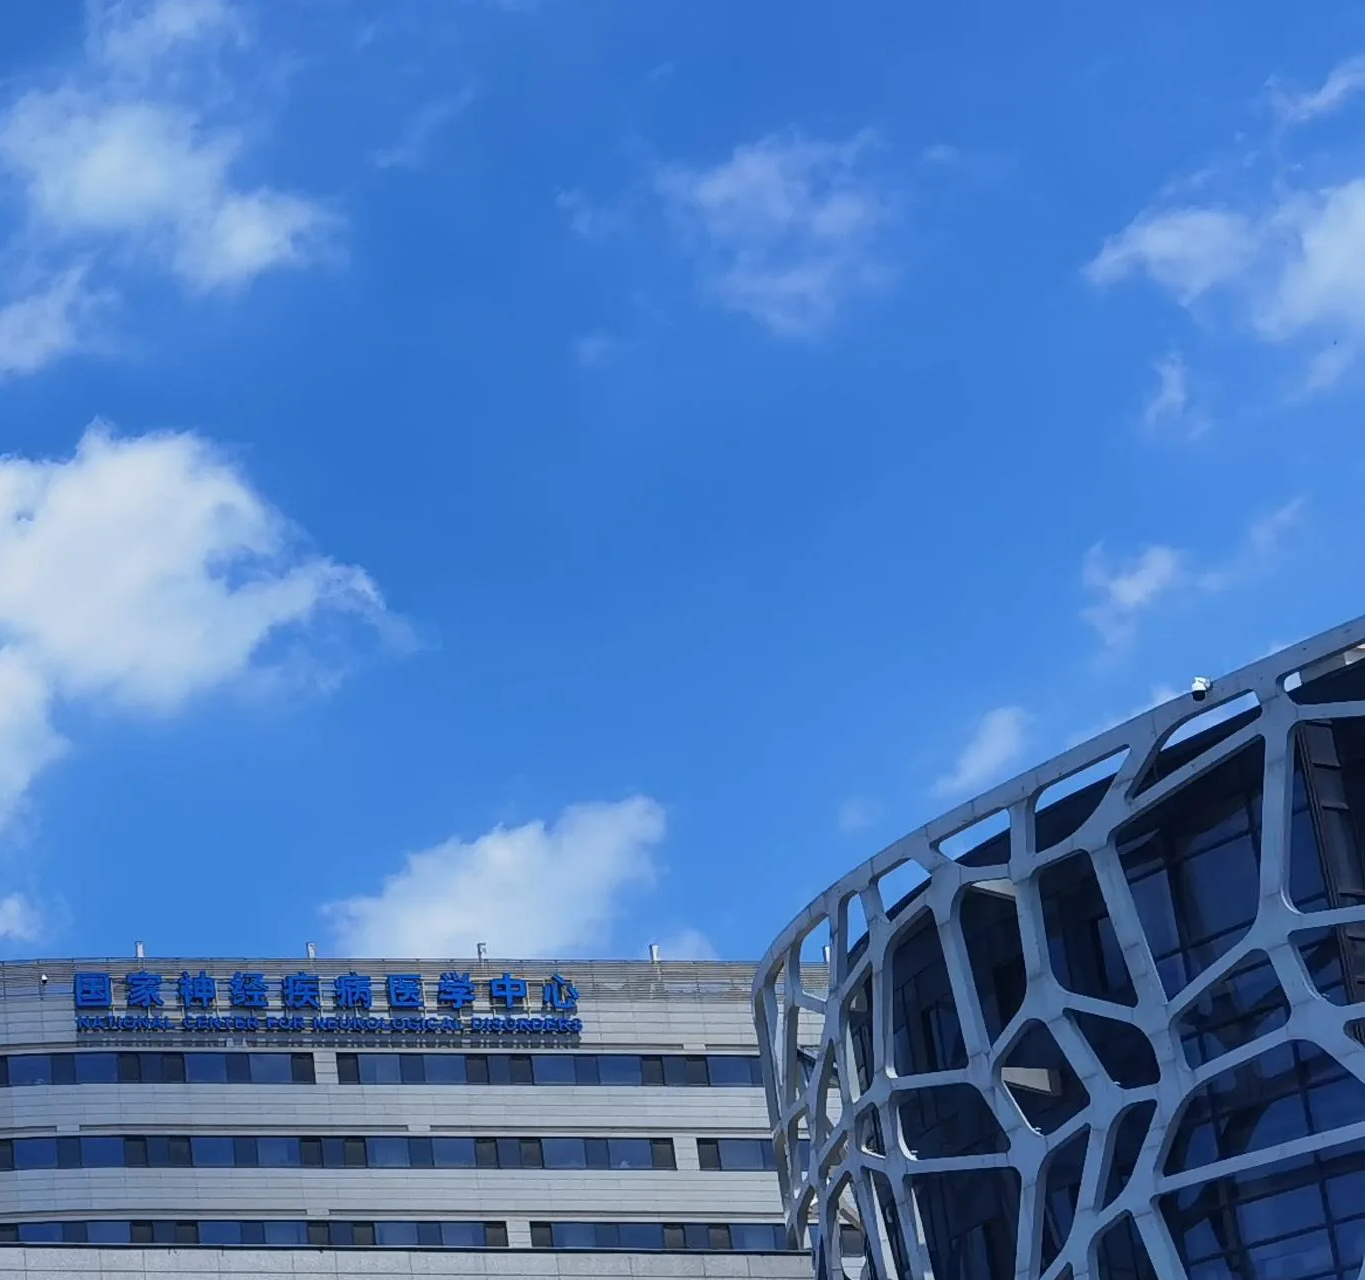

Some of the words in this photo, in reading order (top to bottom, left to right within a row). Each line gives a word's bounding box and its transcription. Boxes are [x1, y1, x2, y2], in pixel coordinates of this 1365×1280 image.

[73, 971, 579, 1010] 国家神经疾病医学中心
[76, 1016, 175, 1031] NATIONAL
[183, 1016, 260, 1031] CENTER
[267, 1017, 304, 1030] FOR
[313, 1017, 463, 1031] NEUROLOGICAL
[471, 1017, 583, 1032] DISORDERS
